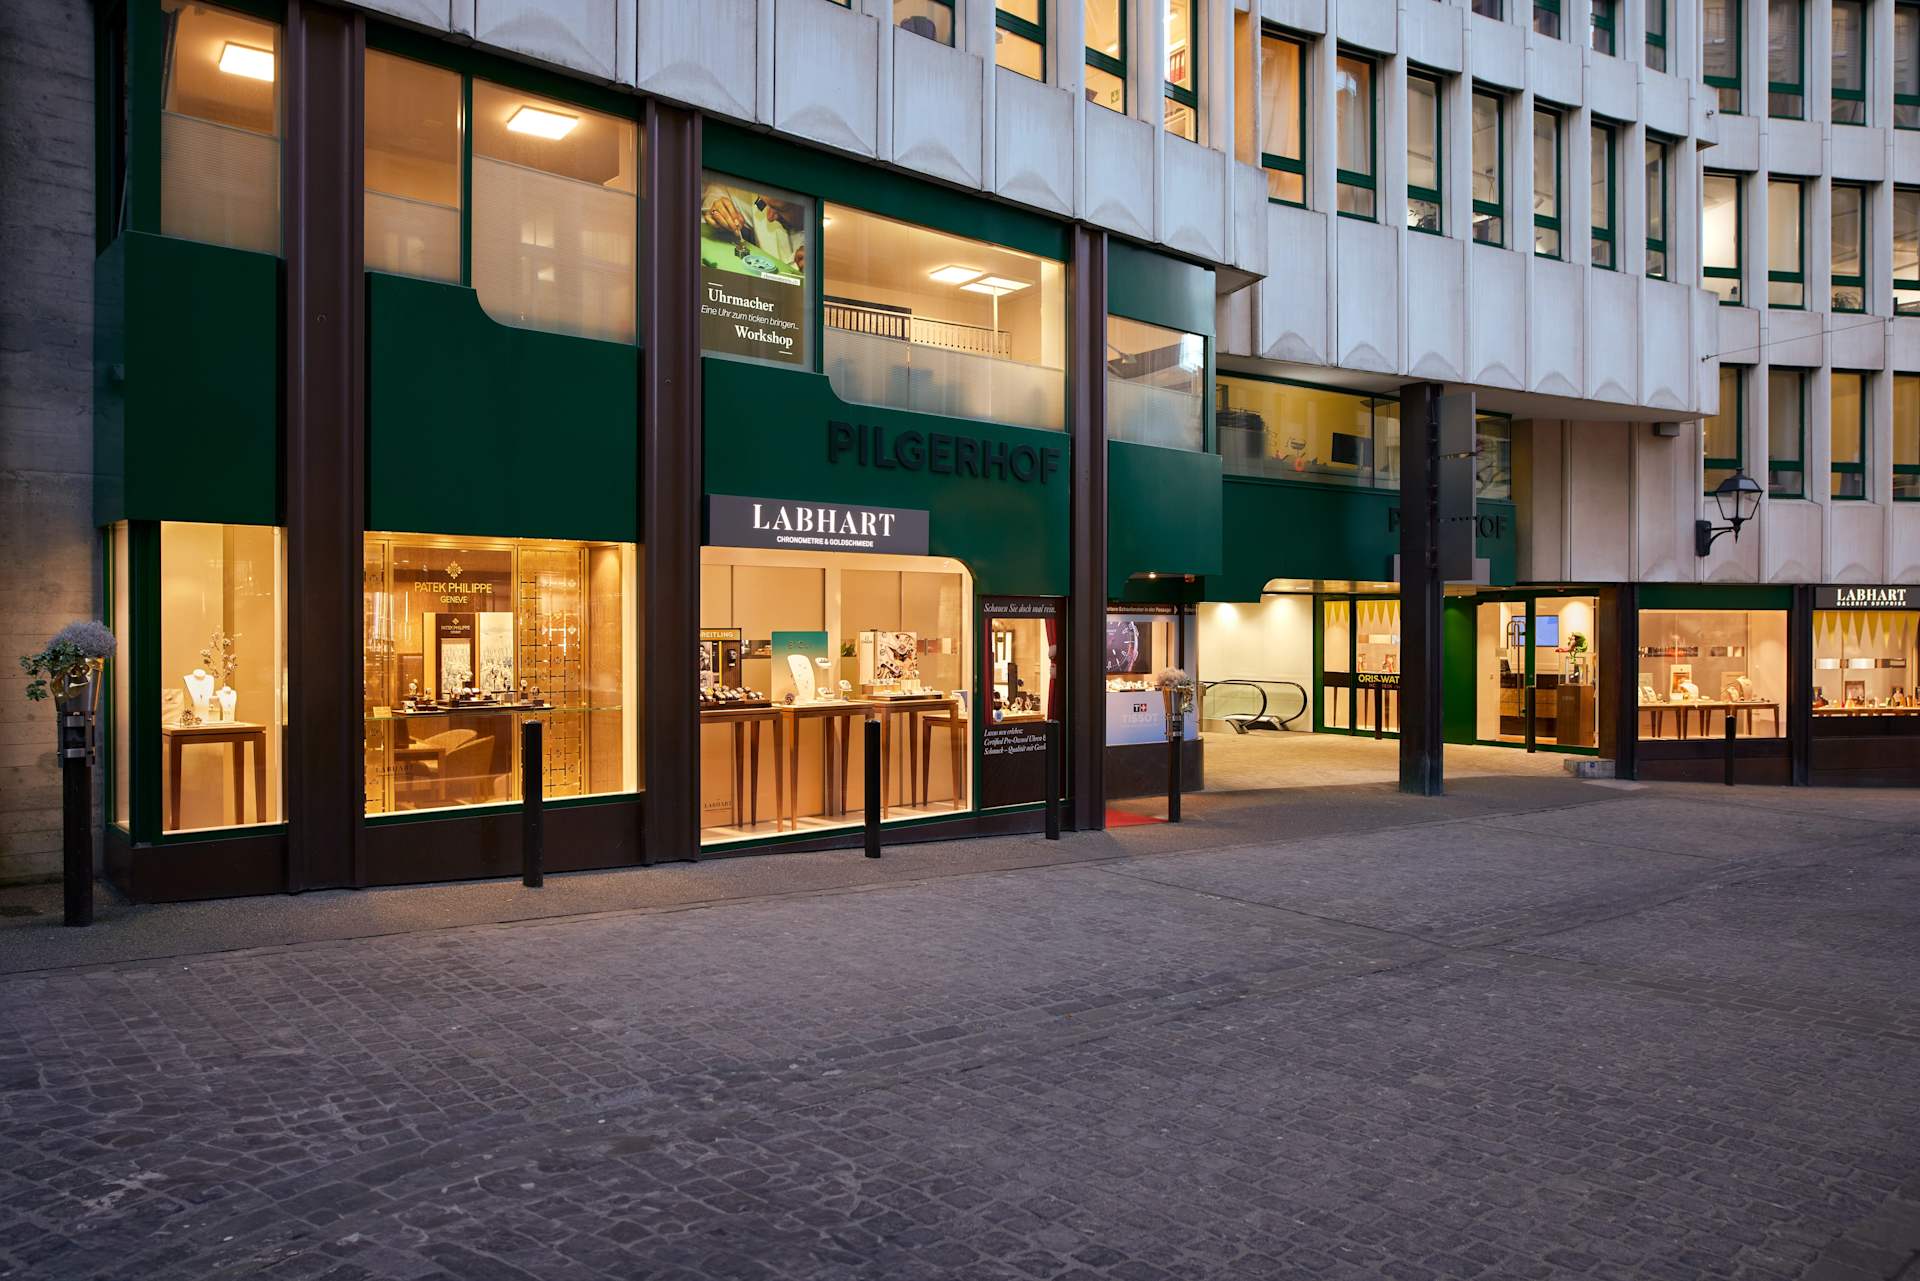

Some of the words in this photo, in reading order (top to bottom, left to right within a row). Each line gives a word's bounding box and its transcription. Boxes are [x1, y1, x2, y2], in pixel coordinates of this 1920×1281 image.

[708, 287, 775, 312] Uhrmacher
[701, 304, 717, 315] Eine
[718, 307, 733, 318] Uhr
[732, 311, 747, 320] zum
[748, 313, 769, 324] ticken
[734, 324, 794, 349] Workshop
[828, 420, 1062, 484] PILGERHOF
[752, 503, 896, 537] LABHART
[776, 535, 824, 545] CHRONOMETRIE
[824, 538, 829, 546] &
[829, 538, 874, 548] GOLDSCHMIEDE
[414, 581, 446, 593] PATEK
[448, 582, 493, 594] PHILIPPE
[1837, 588, 1907, 601] LABHART
[984, 602, 1008, 613] Schauen
[1008, 603, 1018, 613] Sie
[1018, 603, 1032, 613] doch
[700, 631, 734, 639] REITLING
[1358, 674, 1378, 683] ORIS
[1120, 713, 1159, 724] TISSOT
